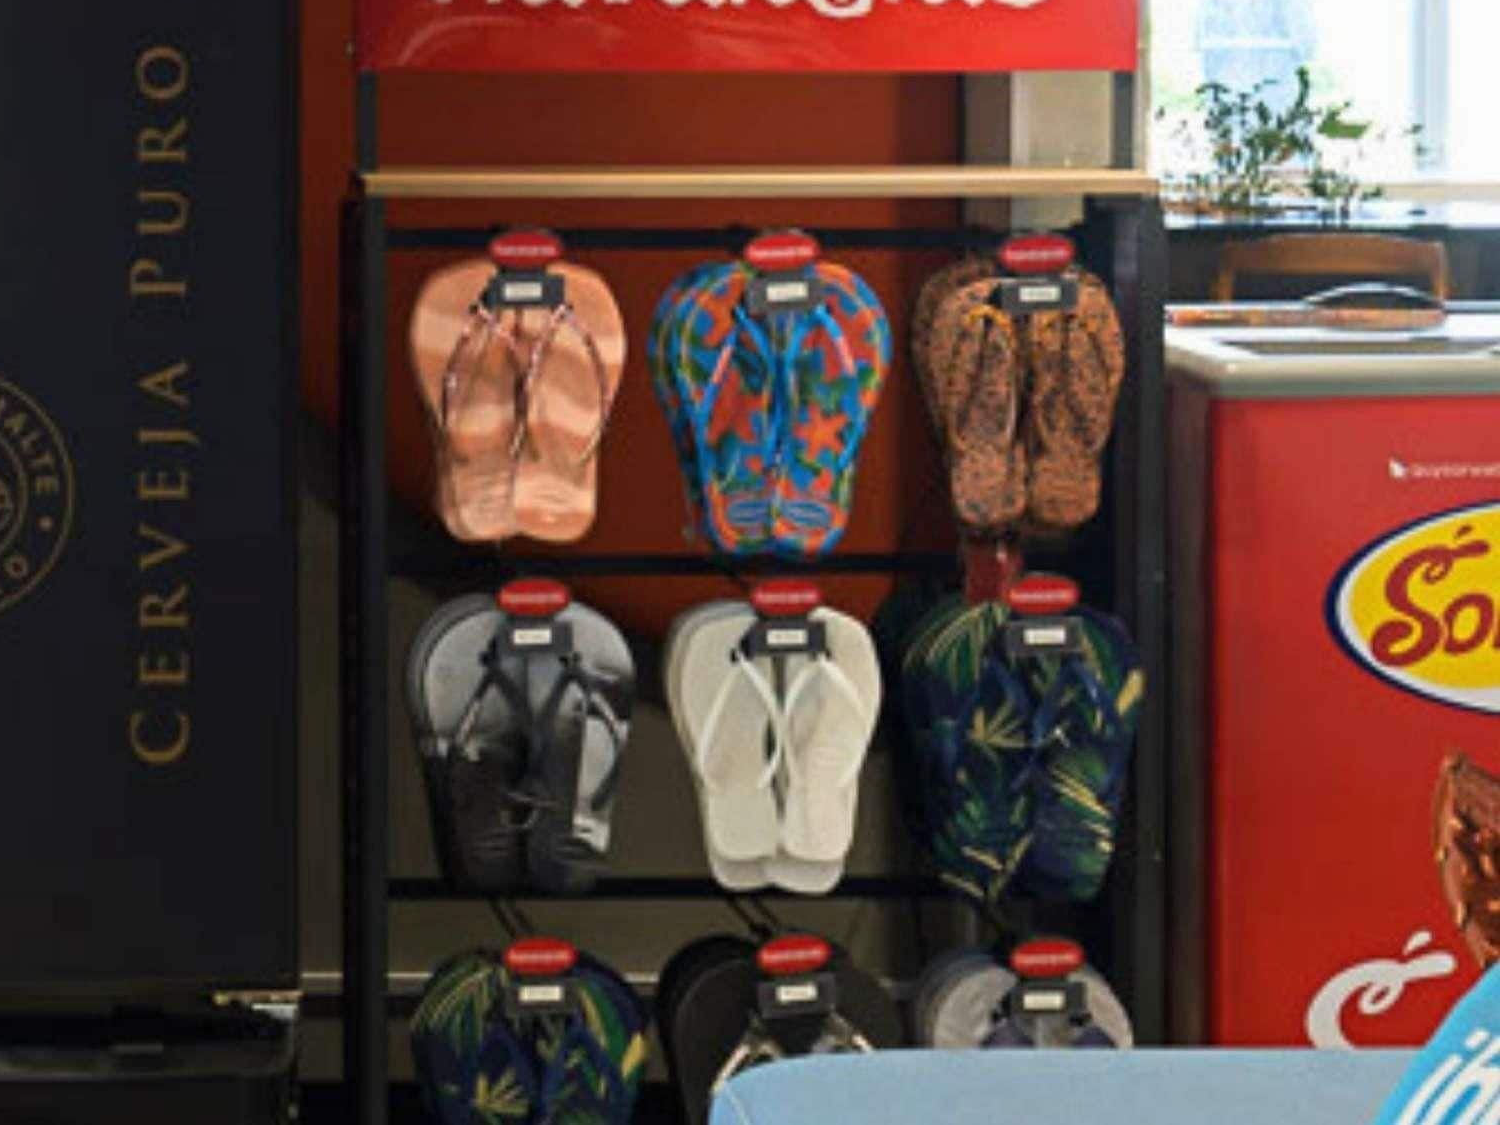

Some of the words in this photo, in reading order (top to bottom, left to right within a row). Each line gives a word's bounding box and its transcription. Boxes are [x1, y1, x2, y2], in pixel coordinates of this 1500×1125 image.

[130, 43, 189, 298] PURO
[129, 359, 197, 764] CERVEJA
[1371, 526, 1500, 666] So
